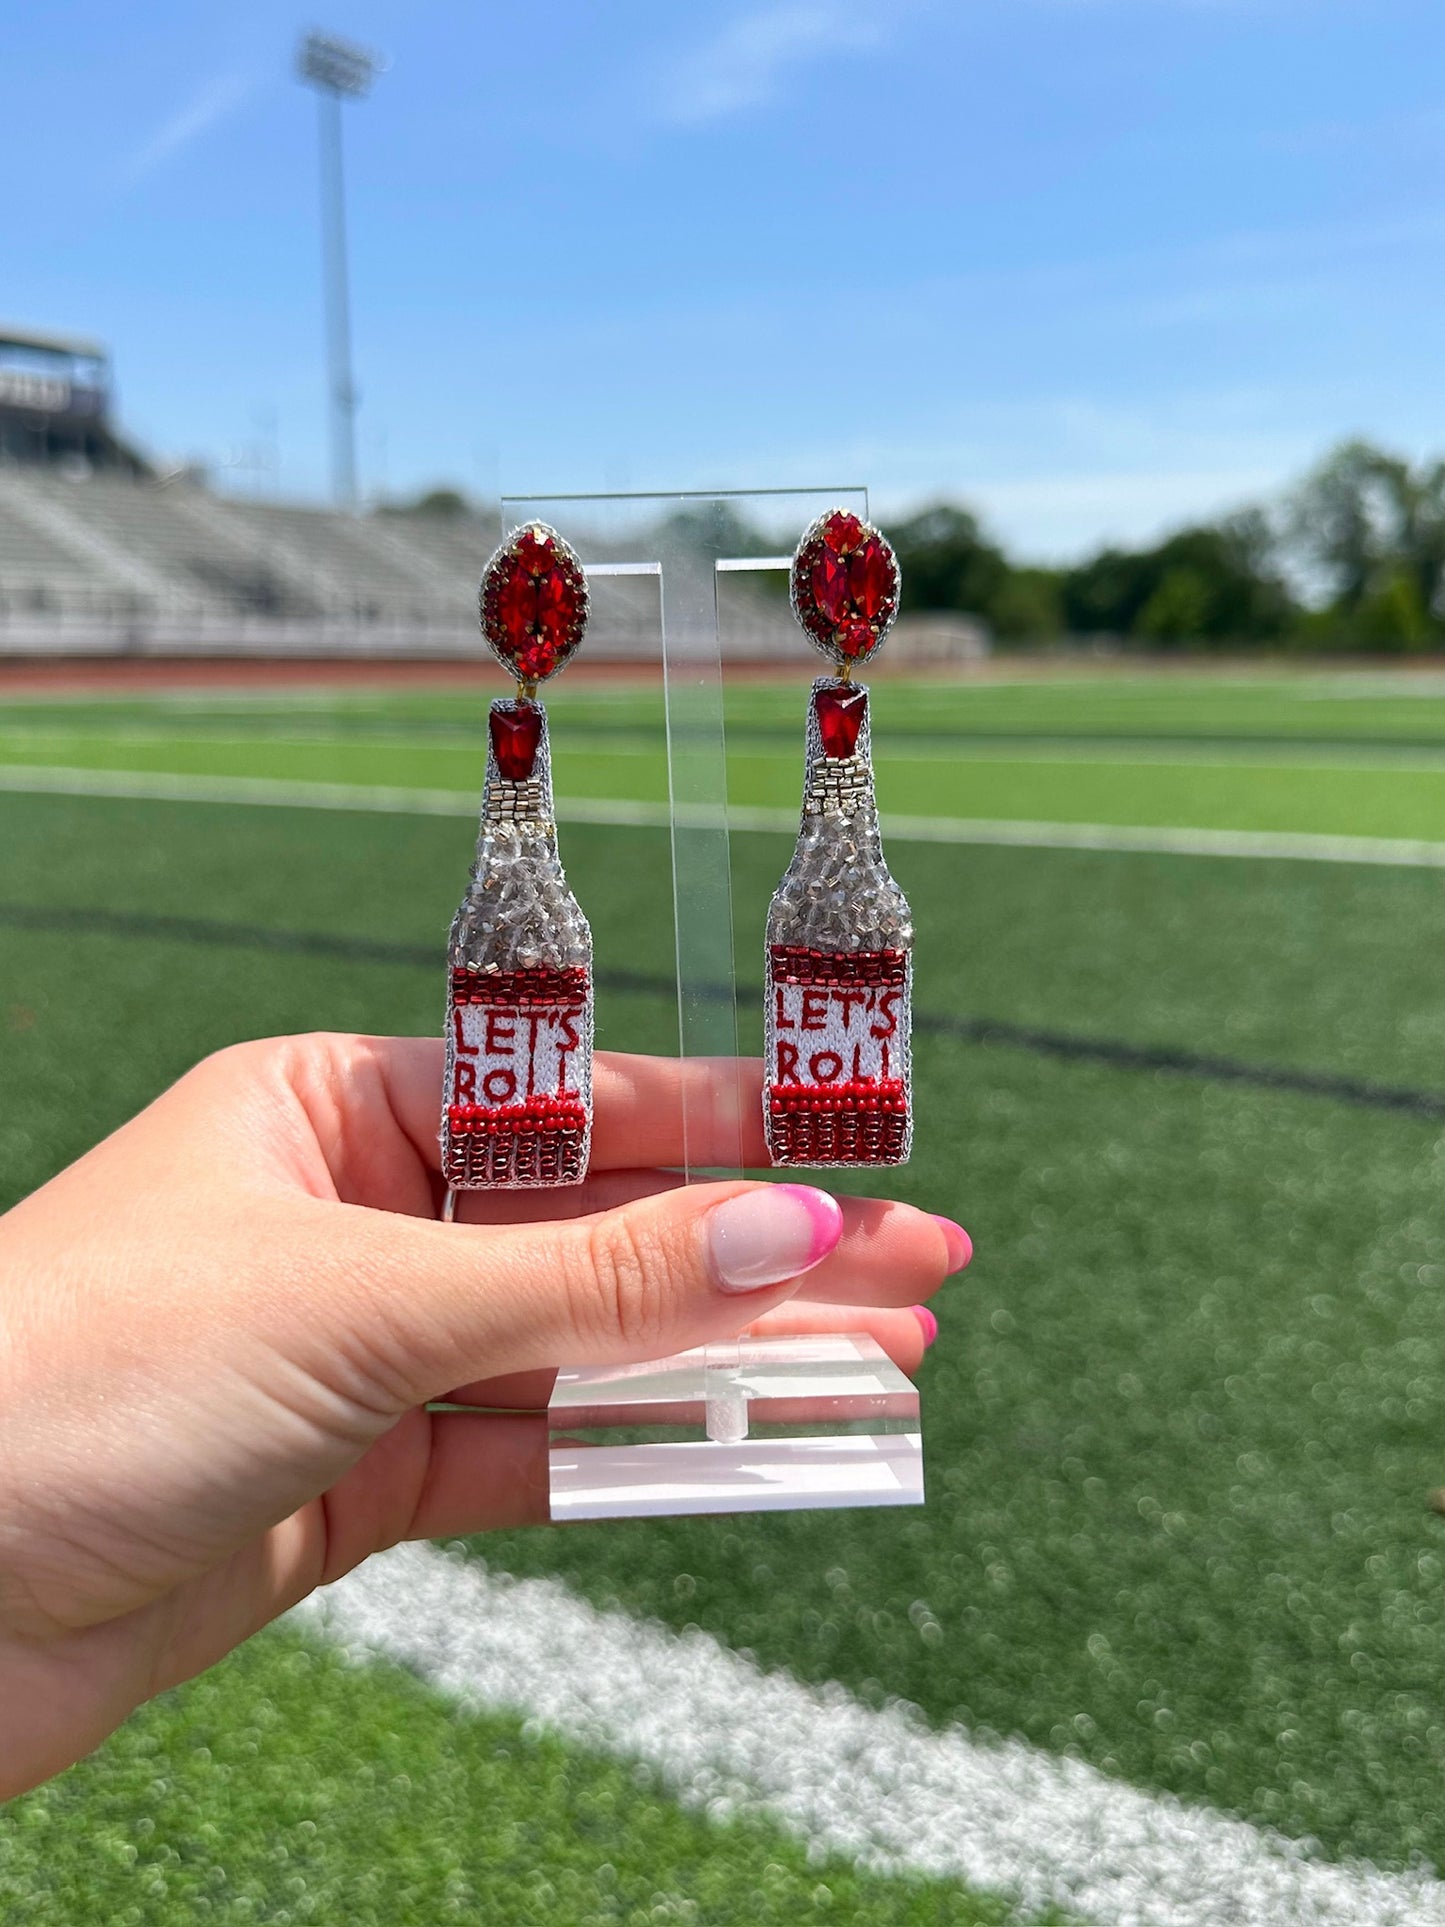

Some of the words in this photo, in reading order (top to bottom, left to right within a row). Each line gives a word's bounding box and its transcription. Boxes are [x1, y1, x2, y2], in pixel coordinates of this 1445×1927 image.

[454, 1009, 582, 1055] LET'S
[776, 989, 903, 1039] LET'S
[776, 1040, 904, 1086] ROLL
